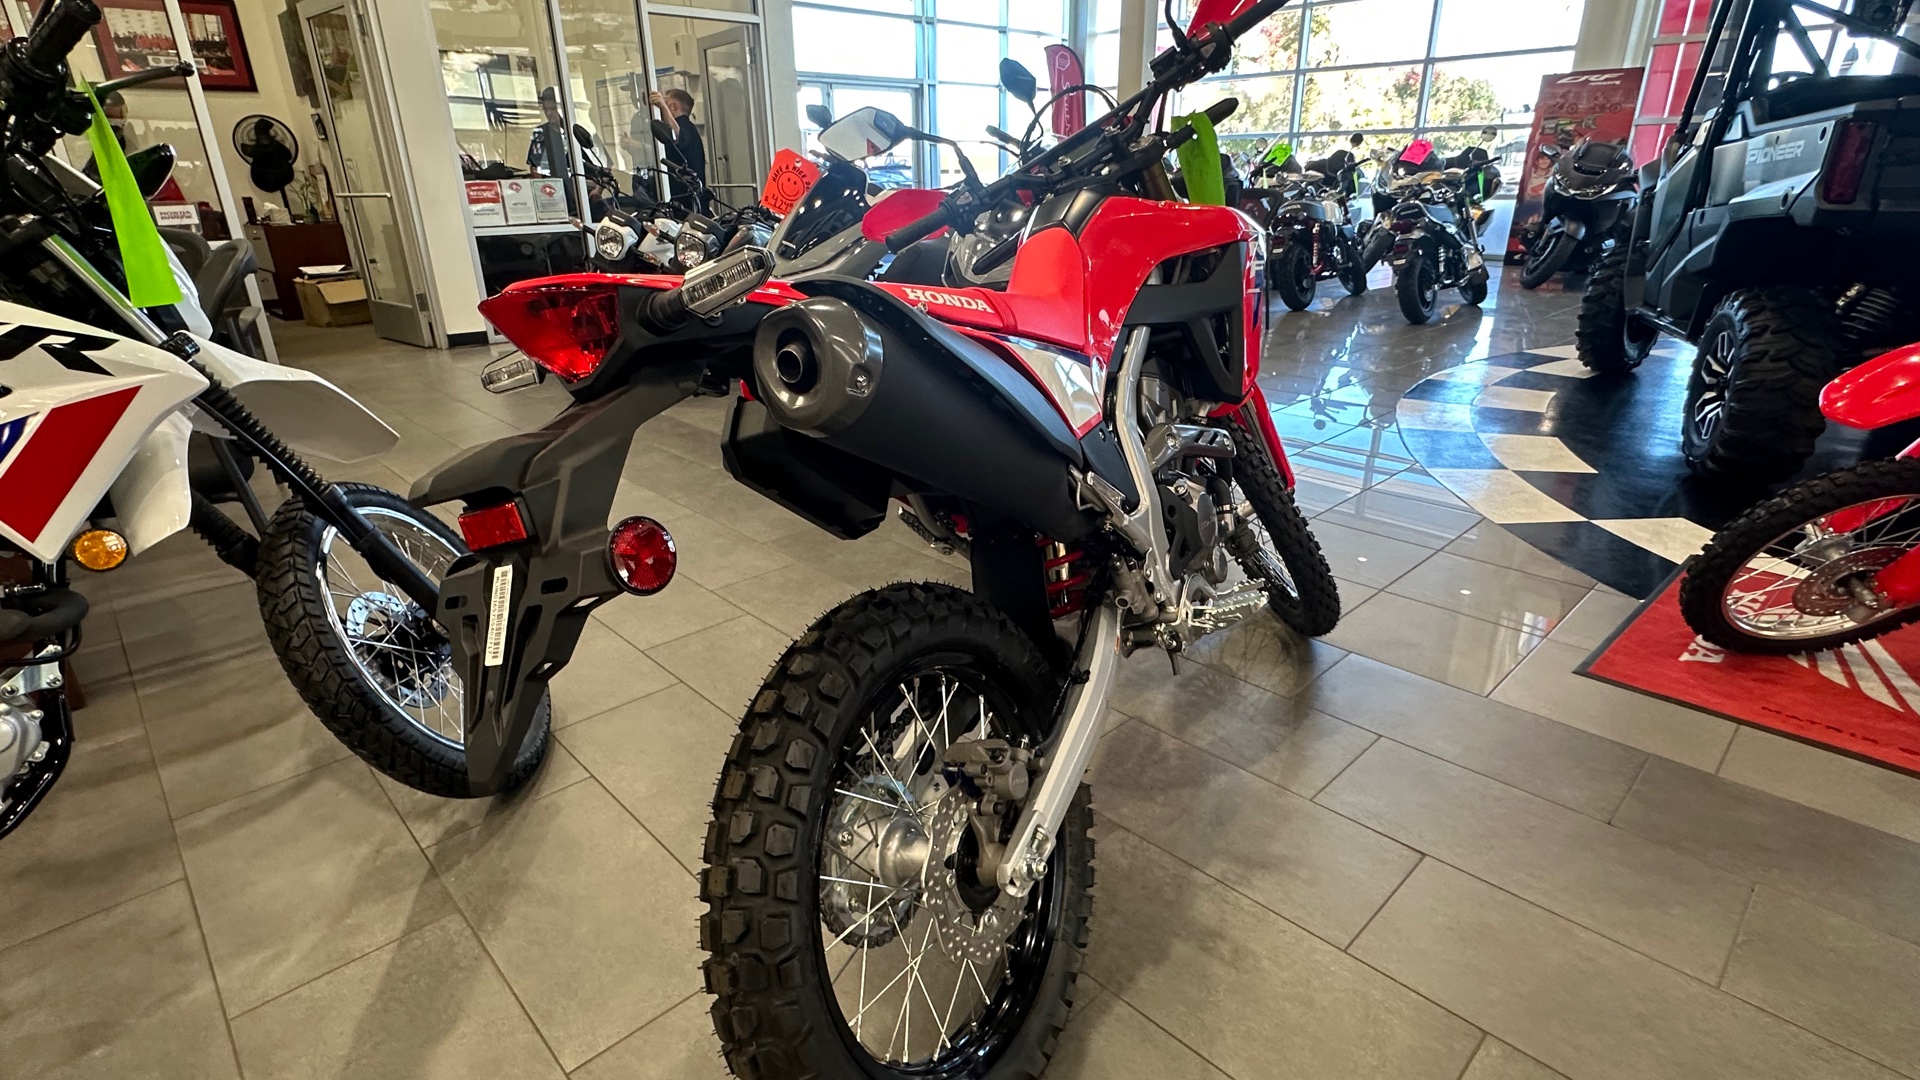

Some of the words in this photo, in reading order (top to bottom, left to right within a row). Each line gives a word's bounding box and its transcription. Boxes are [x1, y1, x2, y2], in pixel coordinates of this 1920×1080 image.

[1556, 72, 1624, 84] CRF
[1745, 140, 1805, 165] PIONEER
[772, 166, 784, 182] HAVE
[791, 165, 807, 179] NICE
[901, 287, 995, 314] HONDA
